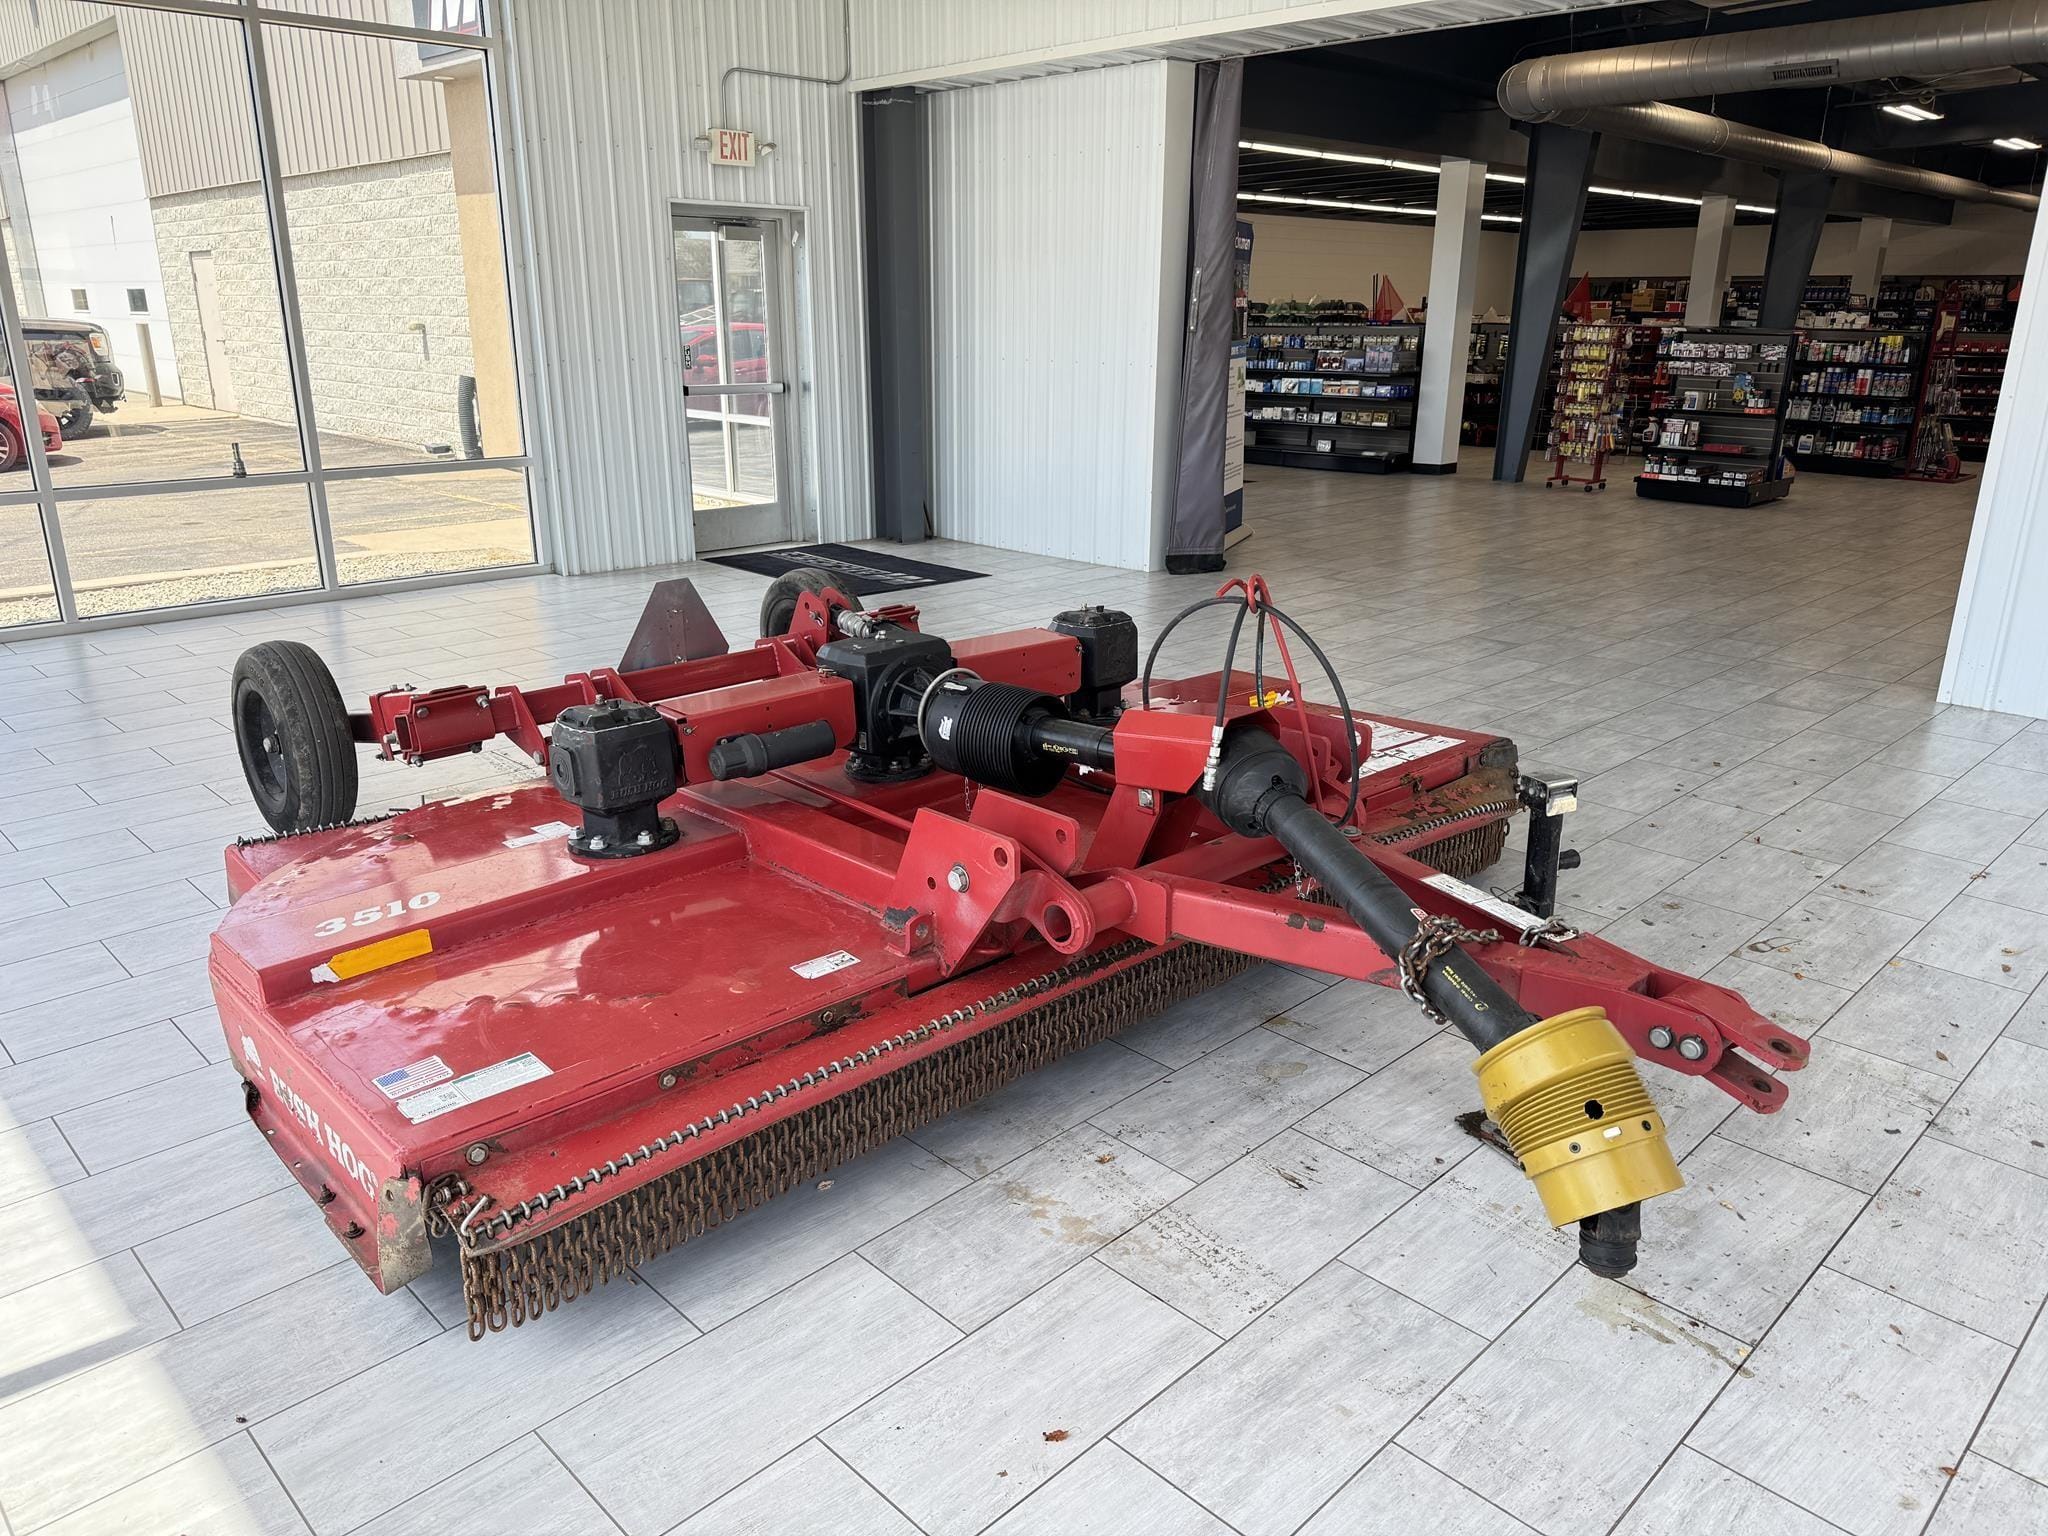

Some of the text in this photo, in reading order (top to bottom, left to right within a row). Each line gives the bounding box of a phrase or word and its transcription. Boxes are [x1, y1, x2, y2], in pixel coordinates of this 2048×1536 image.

[719, 130, 750, 161] EXIT
[314, 891, 441, 937] 3510
[324, 1122, 378, 1203] HOG
